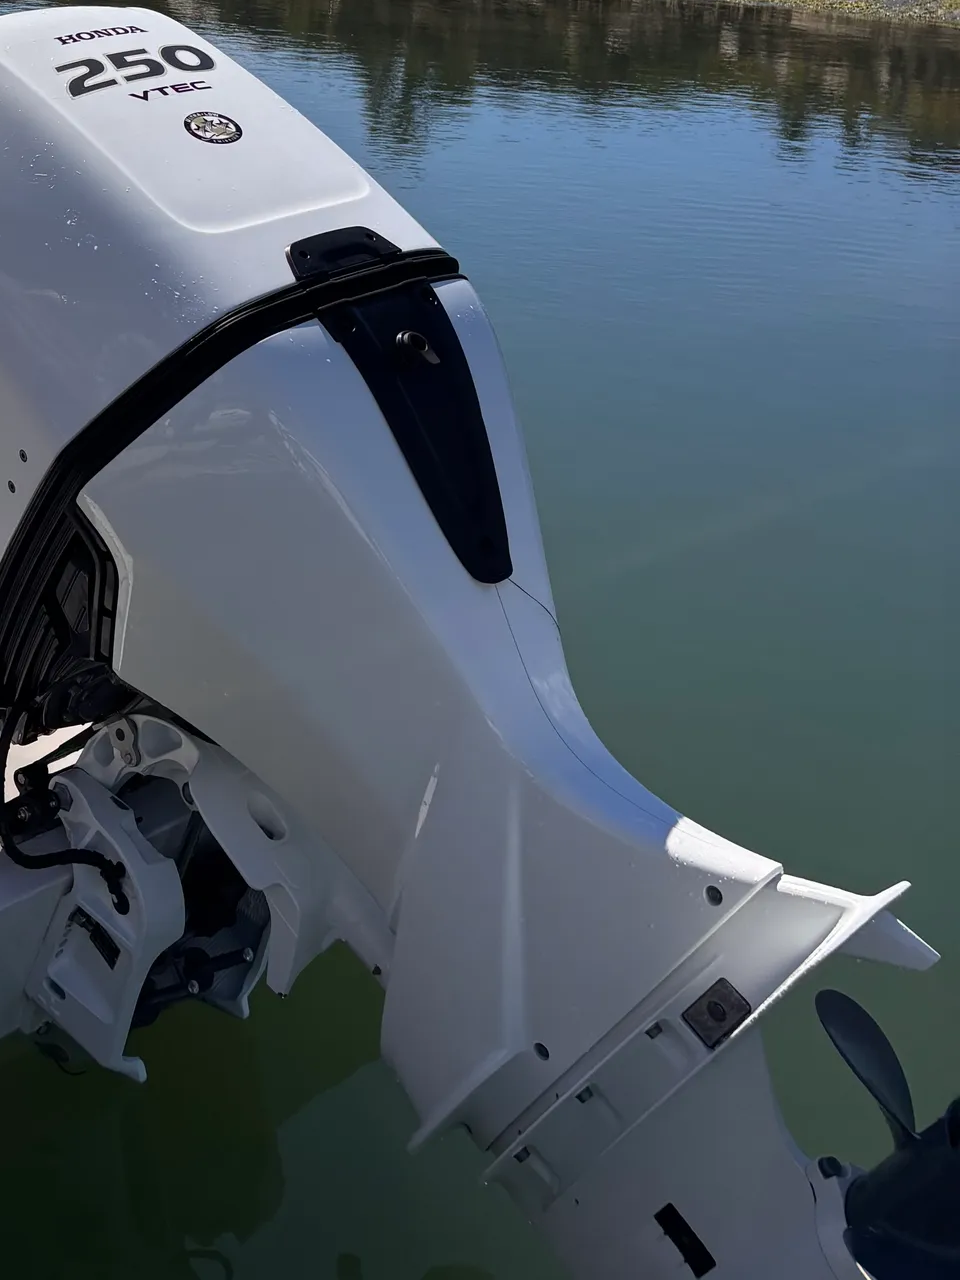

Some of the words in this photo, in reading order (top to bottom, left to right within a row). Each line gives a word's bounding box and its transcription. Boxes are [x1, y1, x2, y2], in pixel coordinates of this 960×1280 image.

[54, 24, 149, 46] HONDA
[53, 44, 217, 100] 250
[128, 80, 213, 102] VTEC
